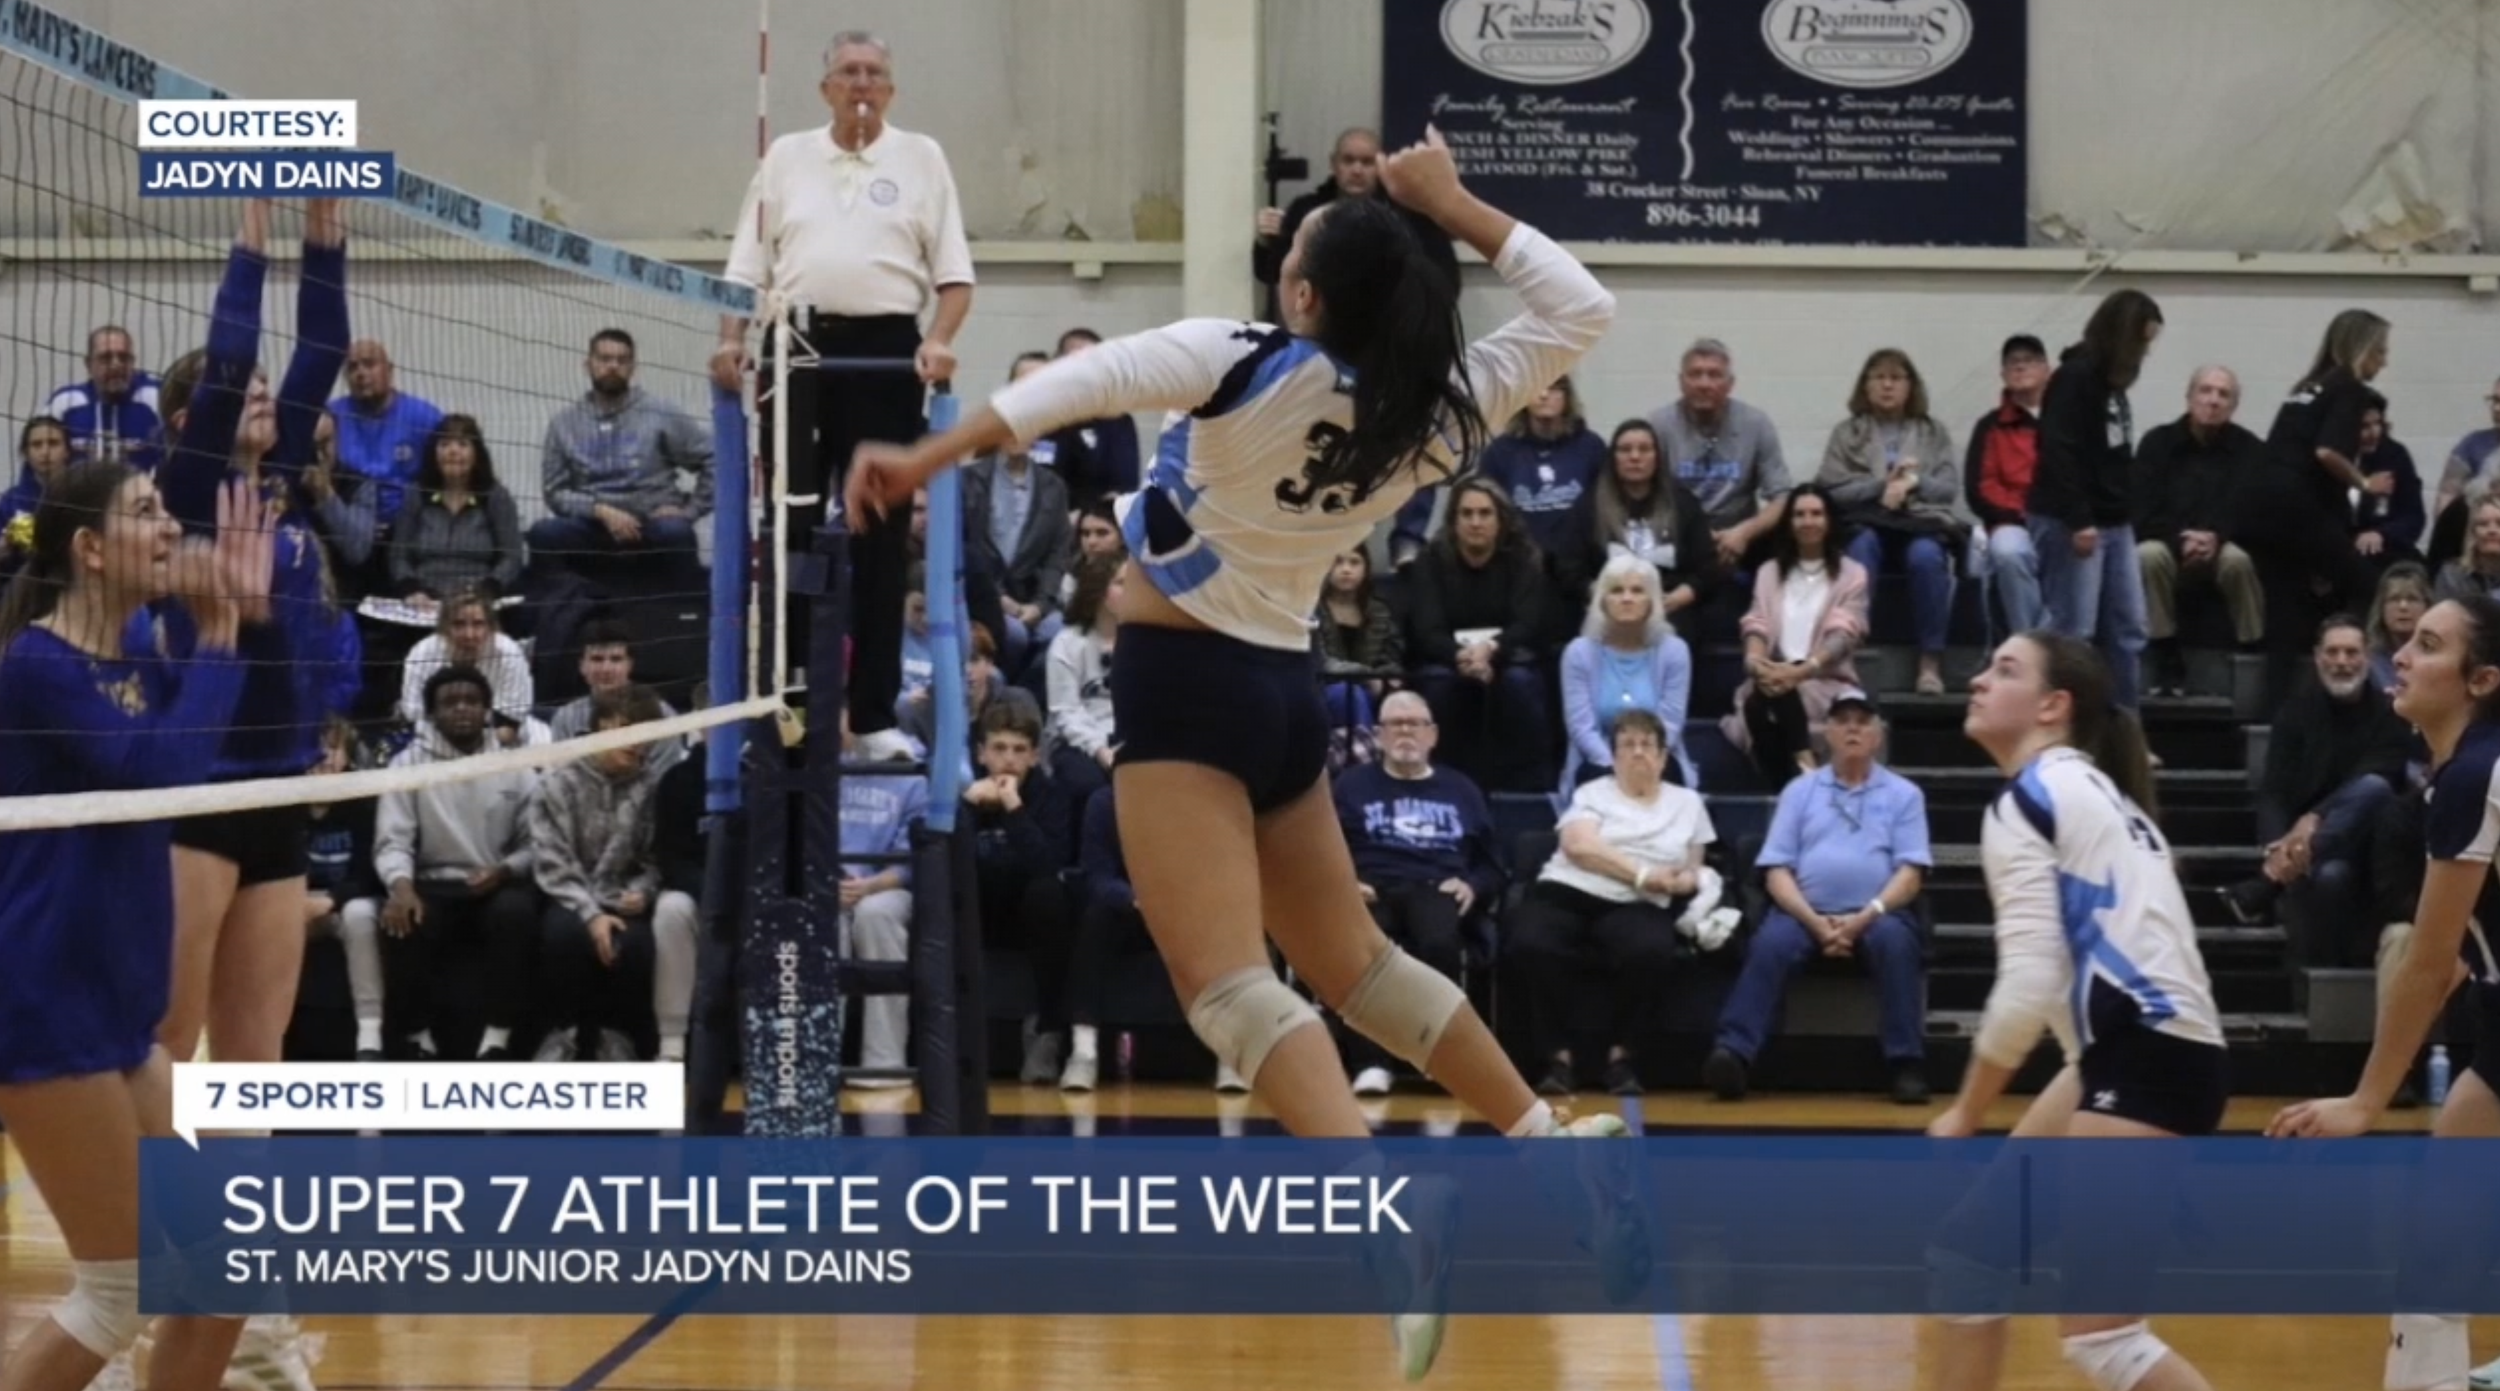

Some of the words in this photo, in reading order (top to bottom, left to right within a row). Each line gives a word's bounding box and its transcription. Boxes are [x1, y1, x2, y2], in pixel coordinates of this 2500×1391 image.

[1432, 93, 1506, 122] Family
[1517, 94, 1638, 115] Restaurant
[1501, 116, 1565, 134] Serving
[1791, 115, 1820, 129] For
[1823, 115, 1854, 132] Any
[1859, 115, 1935, 130] Occasion
[1516, 133, 1591, 146] DINNER
[1595, 134, 1640, 149] Daily
[1727, 130, 1811, 148] Weddings
[1825, 131, 1893, 146] Showers
[1909, 133, 2017, 147] Communions
[1501, 147, 1580, 161] YELLOW
[1586, 148, 1631, 161] PIKE
[1743, 147, 1822, 162] Rehearsal
[1827, 148, 1892, 163] Dinners
[1908, 149, 2002, 163] Graduation
[1457, 162, 1538, 176] EAFOOD
[1580, 163, 1594, 176] &
[1795, 165, 1857, 180] Funeral
[1862, 165, 1948, 181] Breakfasts
[1584, 181, 1605, 198] 38
[1679, 183, 1728, 199] Street
[1795, 184, 1823, 201] NY
[1645, 203, 1761, 228] 896-3044
[775, 941, 799, 1015] sports
[775, 1018, 799, 1107] imports
